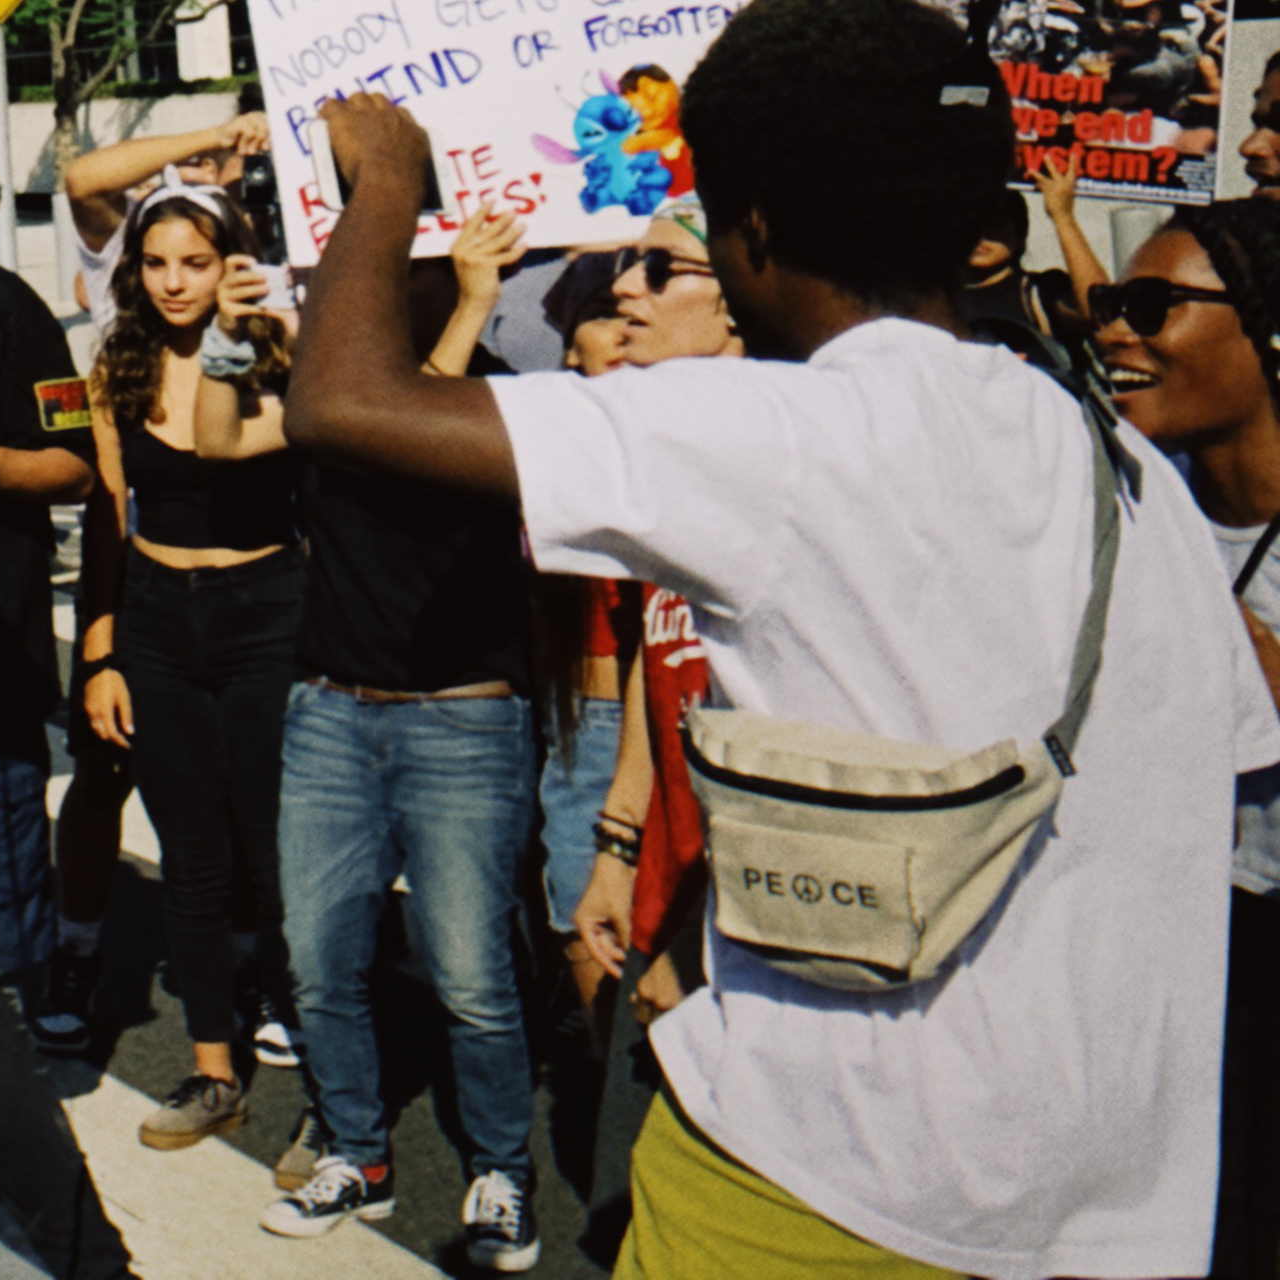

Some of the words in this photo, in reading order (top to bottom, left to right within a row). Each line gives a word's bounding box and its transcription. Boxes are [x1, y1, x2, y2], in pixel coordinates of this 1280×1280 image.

[268, 0, 412, 97] NOBODY
[513, 30, 559, 68] OR
[1073, 108, 1154, 146] end
